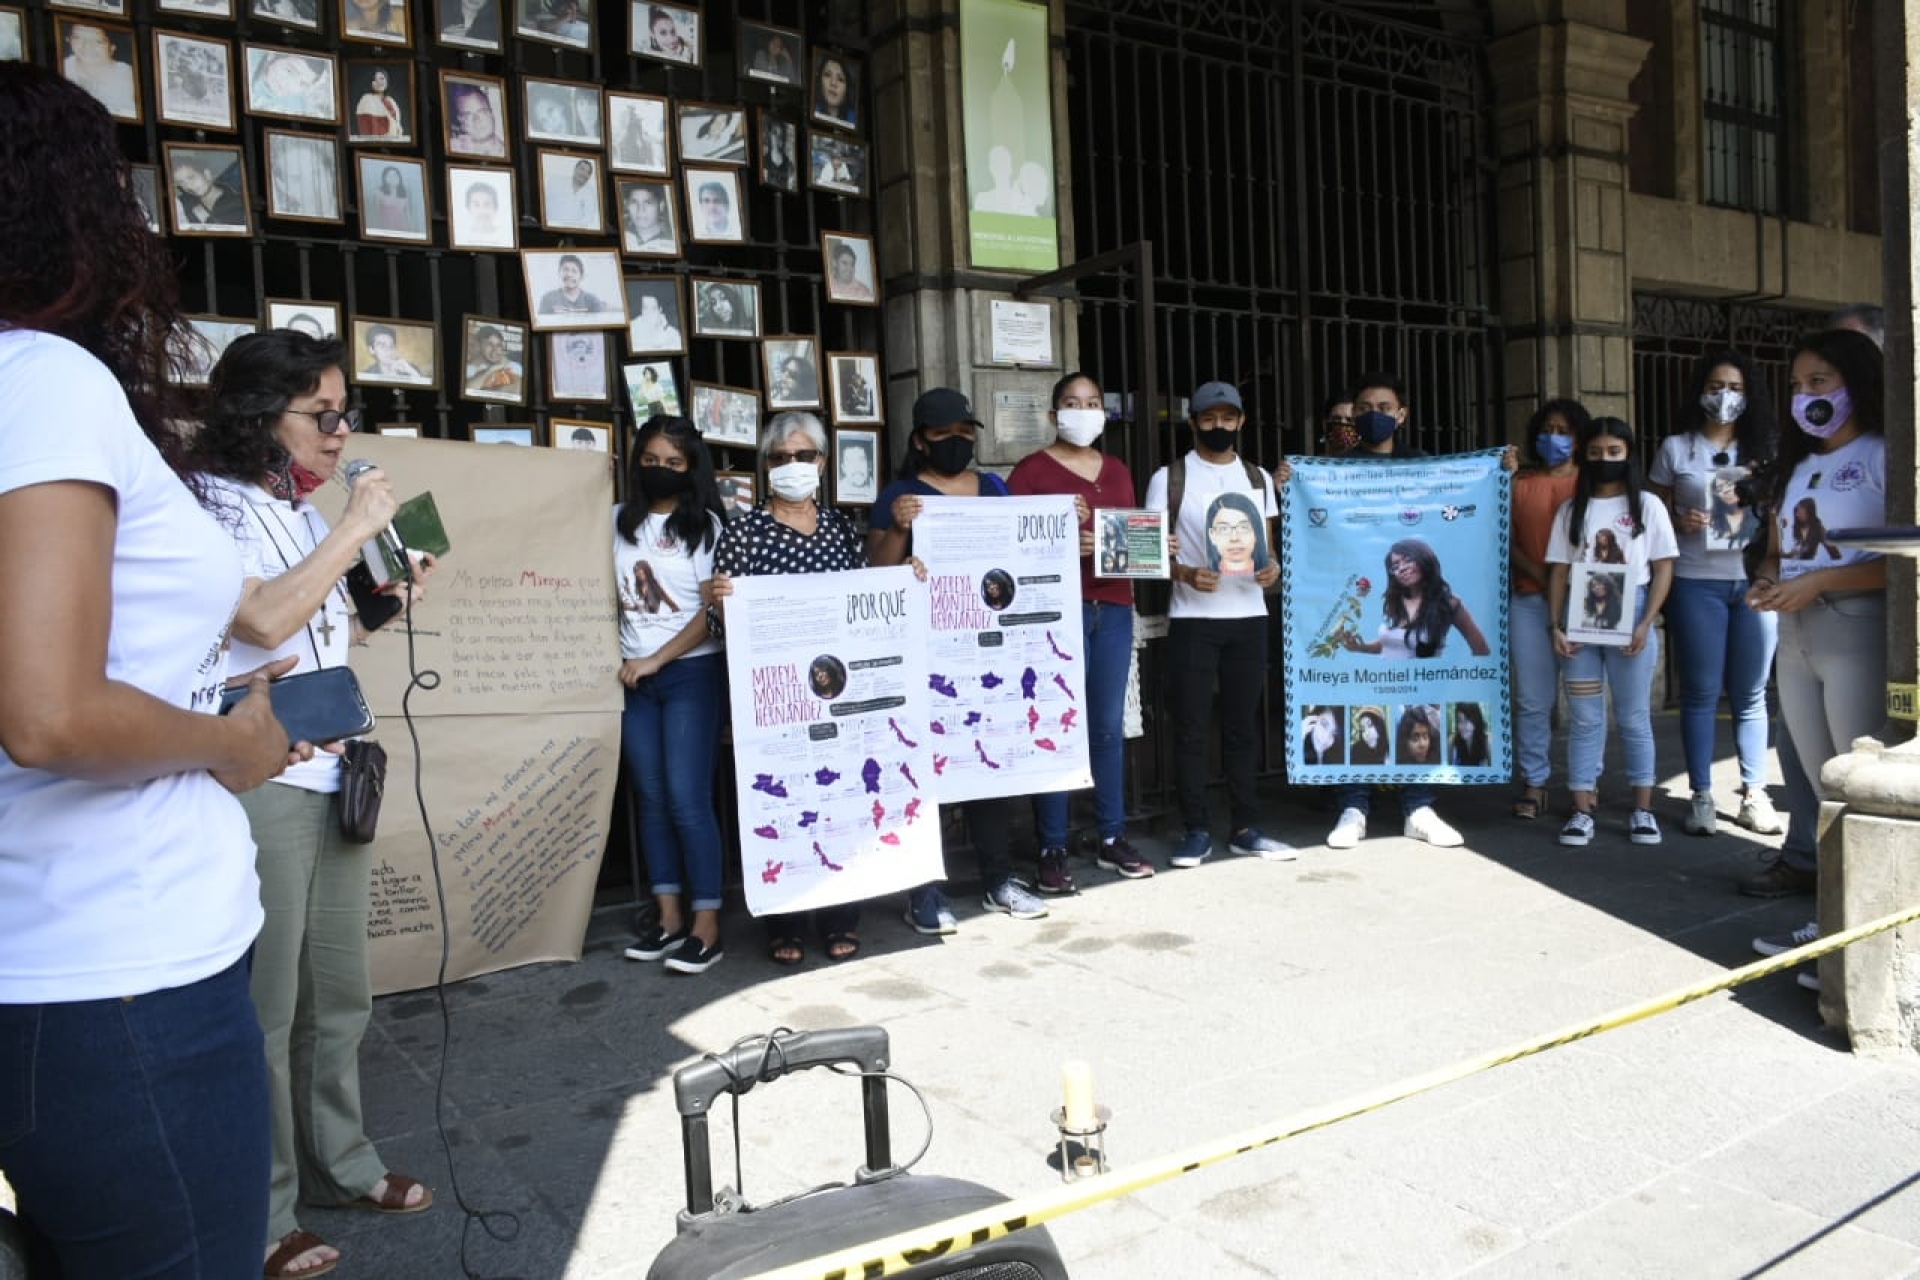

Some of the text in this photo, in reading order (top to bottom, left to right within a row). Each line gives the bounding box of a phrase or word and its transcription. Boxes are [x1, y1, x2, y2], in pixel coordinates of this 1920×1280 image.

[519, 569, 573, 592] Mireya
[929, 575, 972, 595] MIREYA
[930, 593, 982, 613] MONTIEL
[752, 663, 800, 688] MIREYA
[1299, 665, 1498, 687] Mireya Montiel Hernández
[753, 683, 811, 706] MONTIEL
